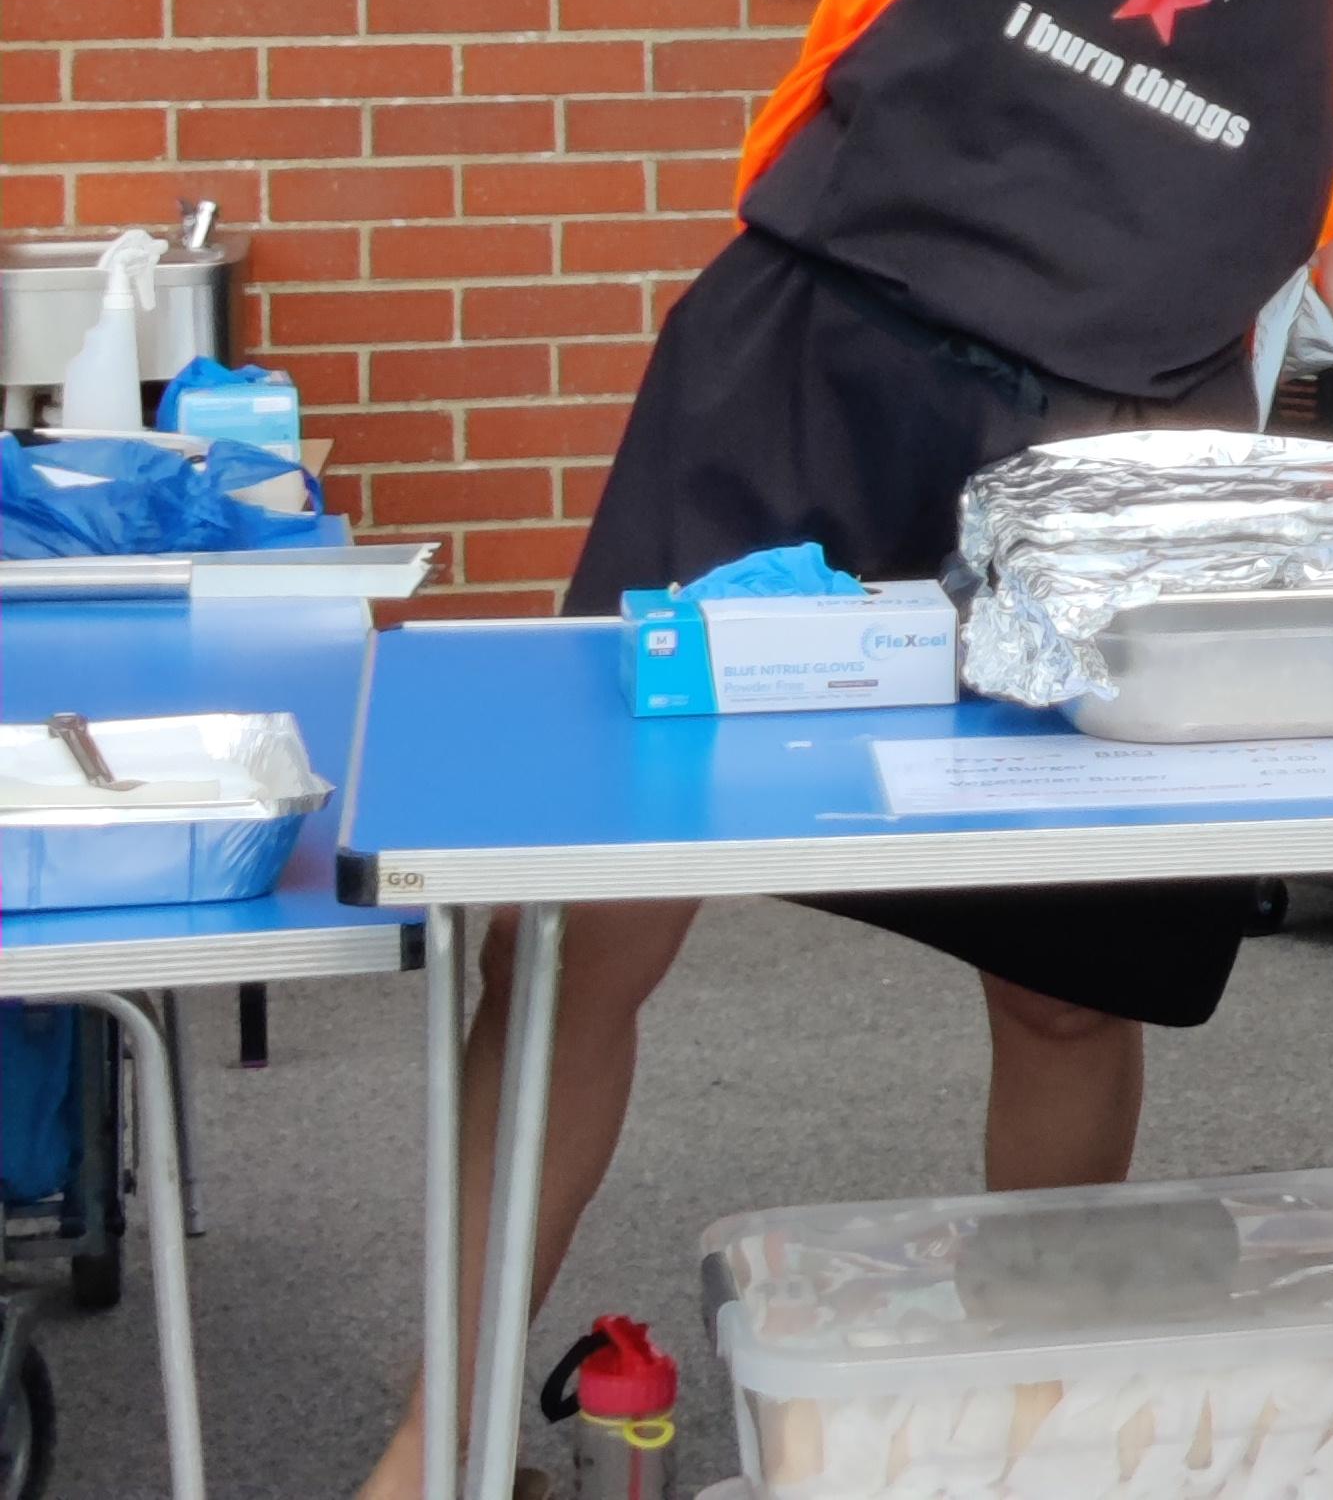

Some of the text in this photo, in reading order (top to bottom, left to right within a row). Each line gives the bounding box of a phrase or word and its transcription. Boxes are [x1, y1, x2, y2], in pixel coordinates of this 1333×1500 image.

[1025, 12, 1125, 87] burn
[1123, 63, 1251, 149] things
[656, 636, 668, 646] M
[724, 661, 865, 678] BLUE NITRILE GLOVES
